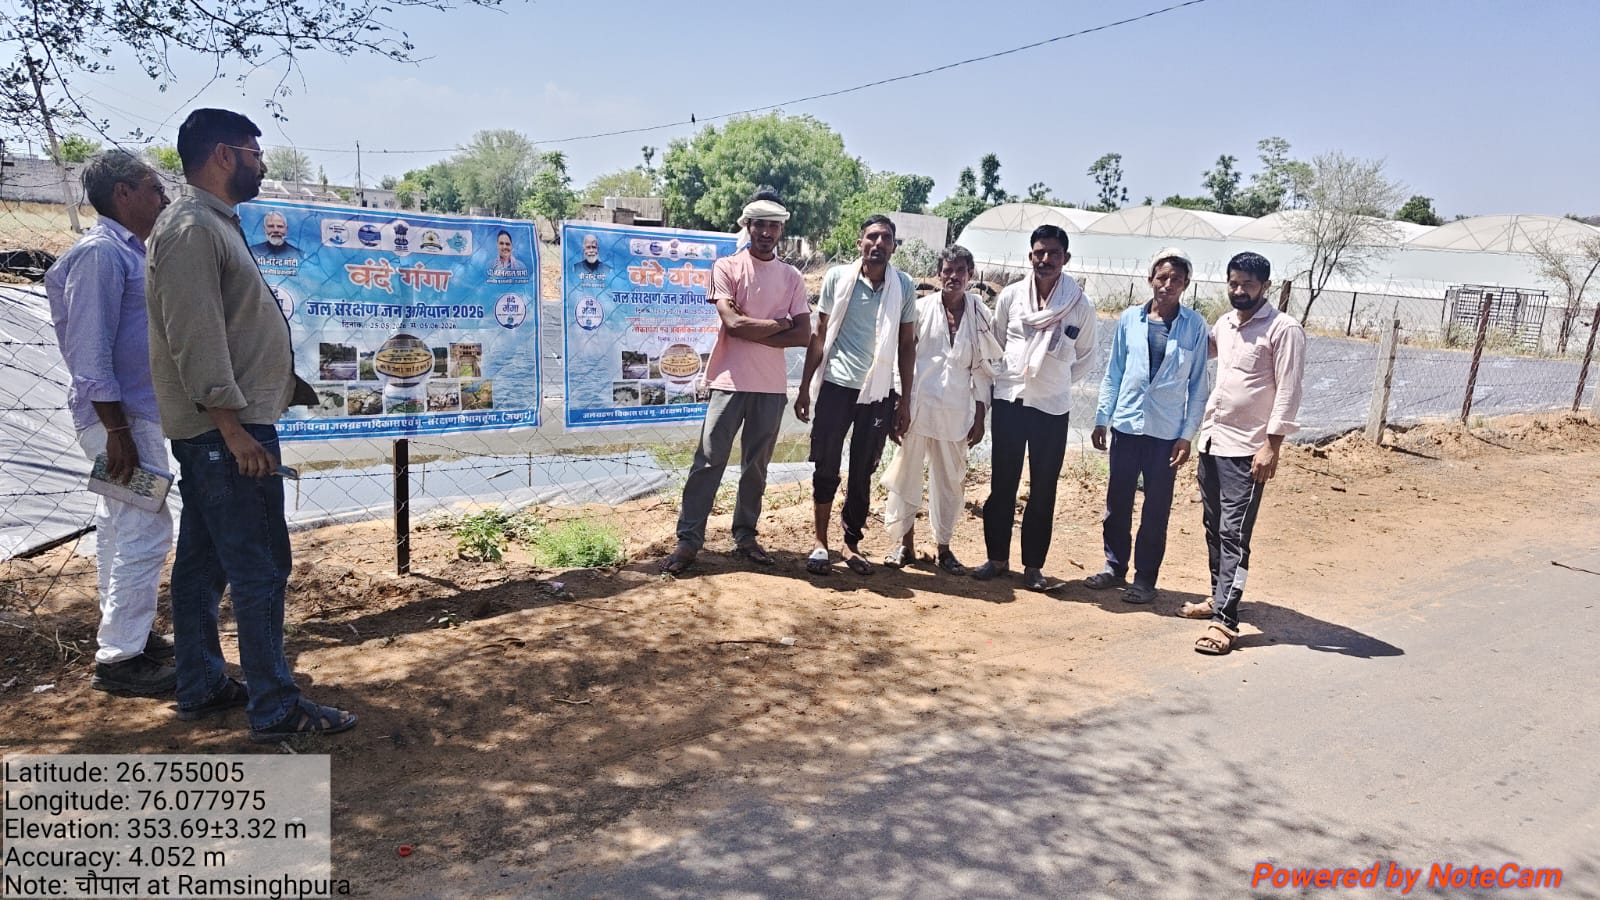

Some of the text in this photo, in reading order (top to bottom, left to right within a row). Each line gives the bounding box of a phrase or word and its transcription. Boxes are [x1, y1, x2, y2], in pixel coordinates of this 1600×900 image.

[345, 258, 453, 293] वंदे गंगा
[628, 260, 710, 288] वंदे गंग
[307, 299, 484, 319] जल संरक्षण जन अभियान 2026
[612, 289, 707, 305] जल संरक्षण जन अभिया
